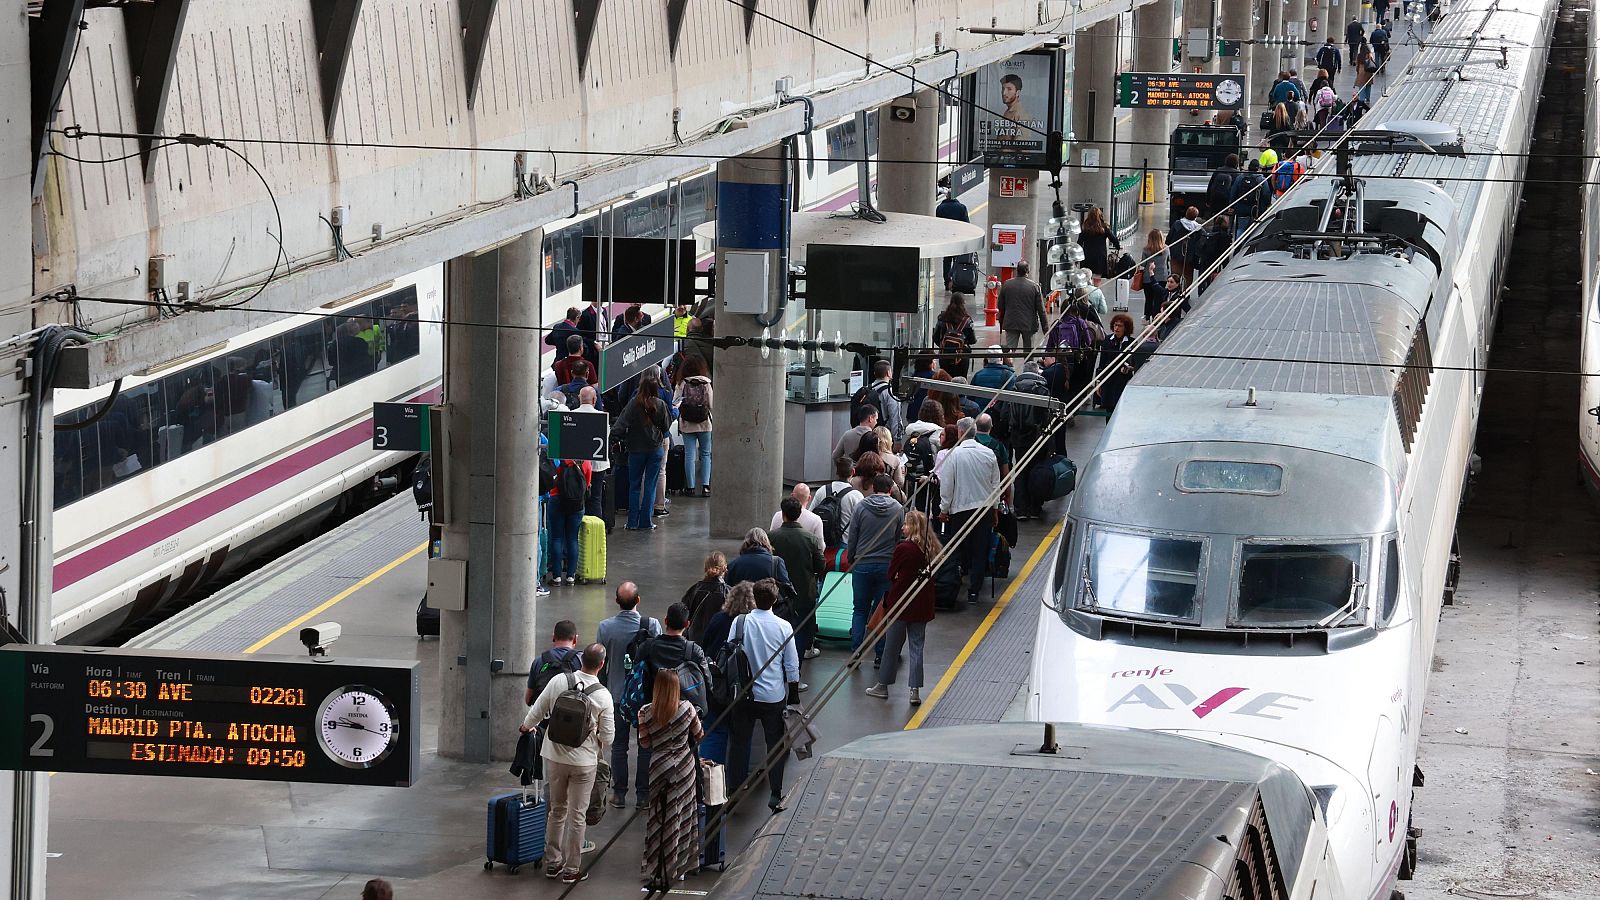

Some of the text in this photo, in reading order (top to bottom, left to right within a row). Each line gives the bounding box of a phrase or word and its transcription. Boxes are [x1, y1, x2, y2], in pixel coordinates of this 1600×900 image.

[1235, 48, 1239, 56] 2
[1130, 91, 1139, 105] 2
[376, 426, 388, 447] 3
[592, 437, 604, 458] 2
[32, 663, 49, 675] Vía
[86, 666, 142, 679] Hora TIME
[156, 669, 181, 680] Tren
[1111, 665, 1174, 679] renfe
[30, 682, 64, 690] PLATFORM
[88, 679, 306, 706] 06:30 AVE 02261
[352, 696, 366, 705] 12
[1105, 683, 1314, 720] AVE
[85, 703, 184, 718] Destino DESTINATION
[88, 716, 297, 743] MADRID PTA. ATOCHA
[328, 720, 337, 729] 9
[379, 723, 388, 732] 3
[29, 713, 55, 757] 2
[131, 743, 306, 767] ESTIMADO: 09:50
[352, 747, 362, 756] 6
